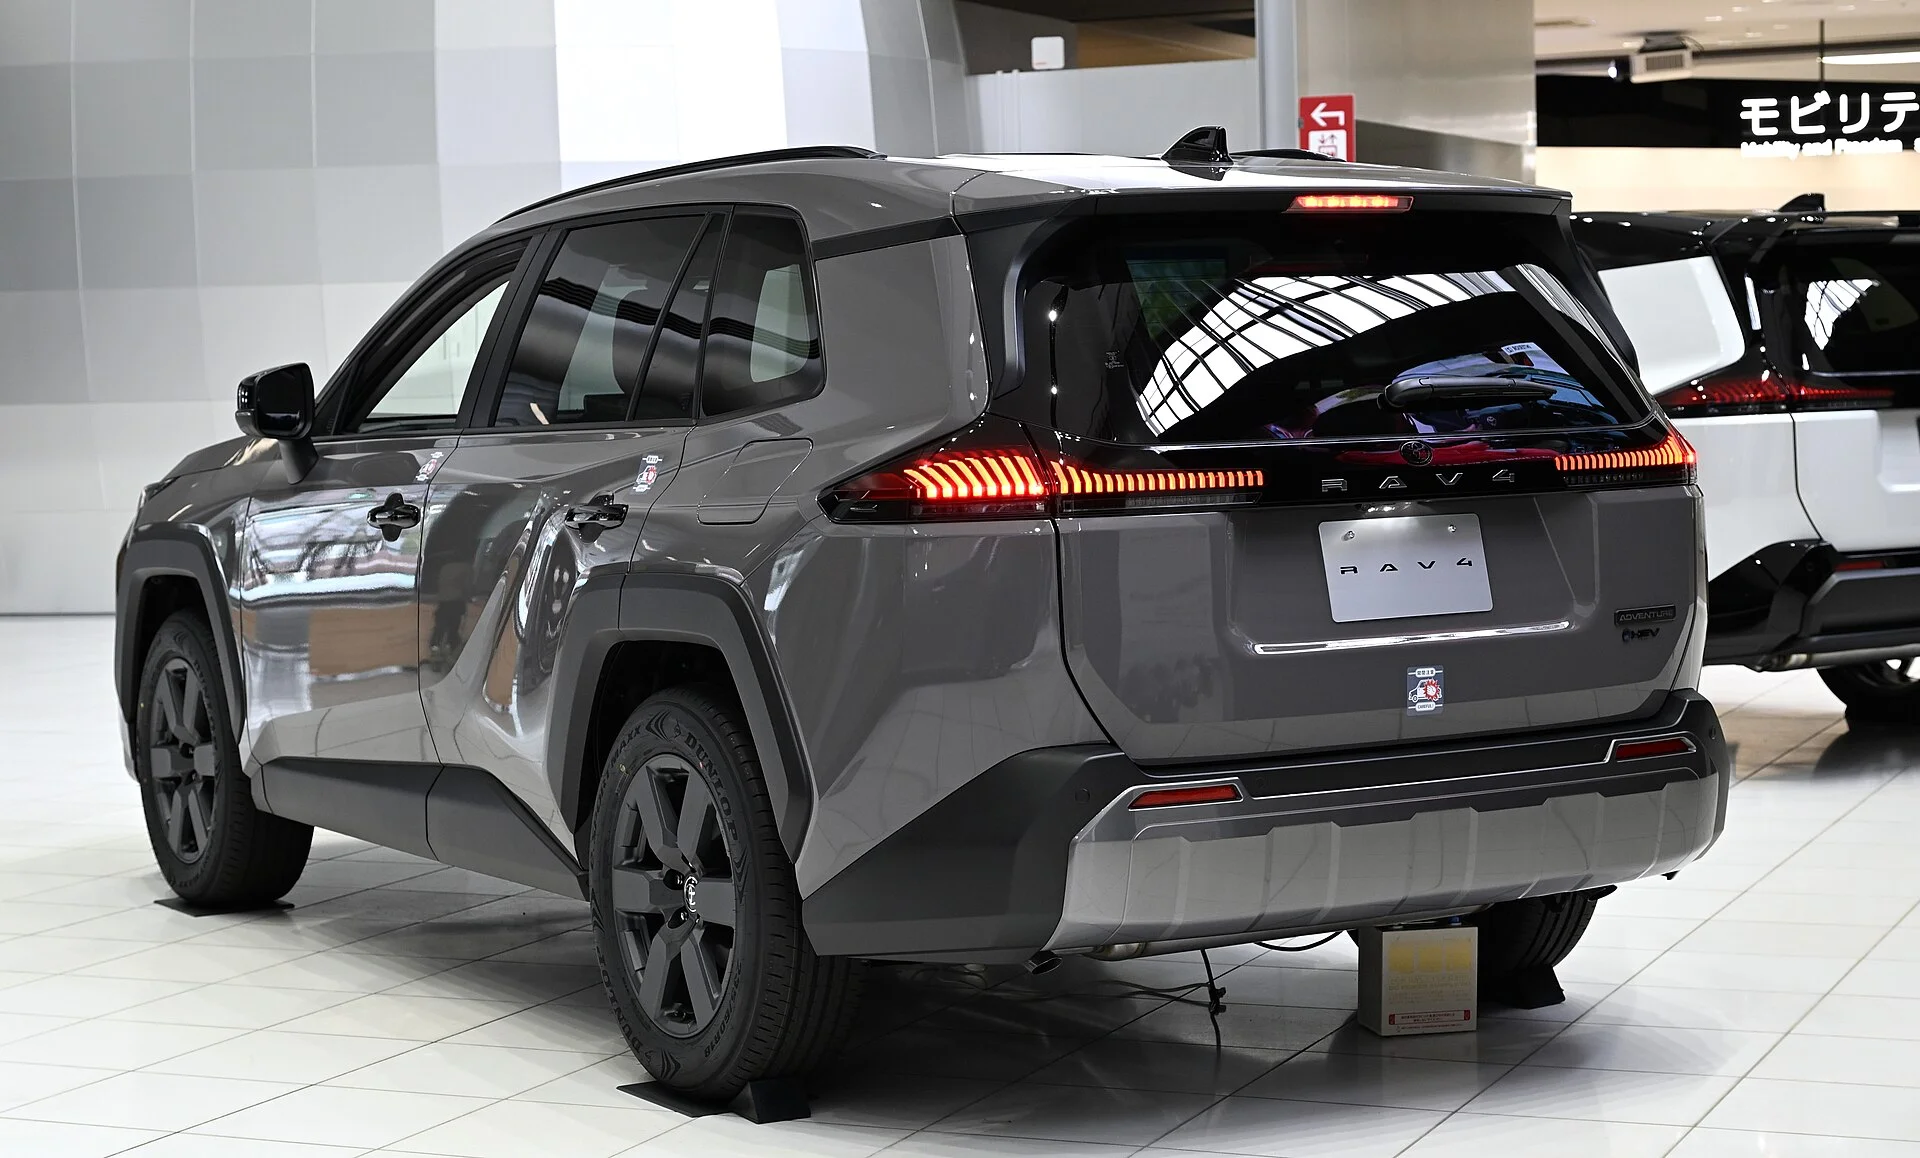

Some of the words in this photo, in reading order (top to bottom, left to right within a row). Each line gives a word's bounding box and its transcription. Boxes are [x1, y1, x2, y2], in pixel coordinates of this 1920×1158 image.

[1740, 90, 1920, 136] モビリテ
[1321, 469, 1515, 492] RAV4
[1340, 557, 1473, 575] RAV4
[1620, 611, 1673, 621] ADVENTURE
[684, 732, 739, 841] DUNLOP
